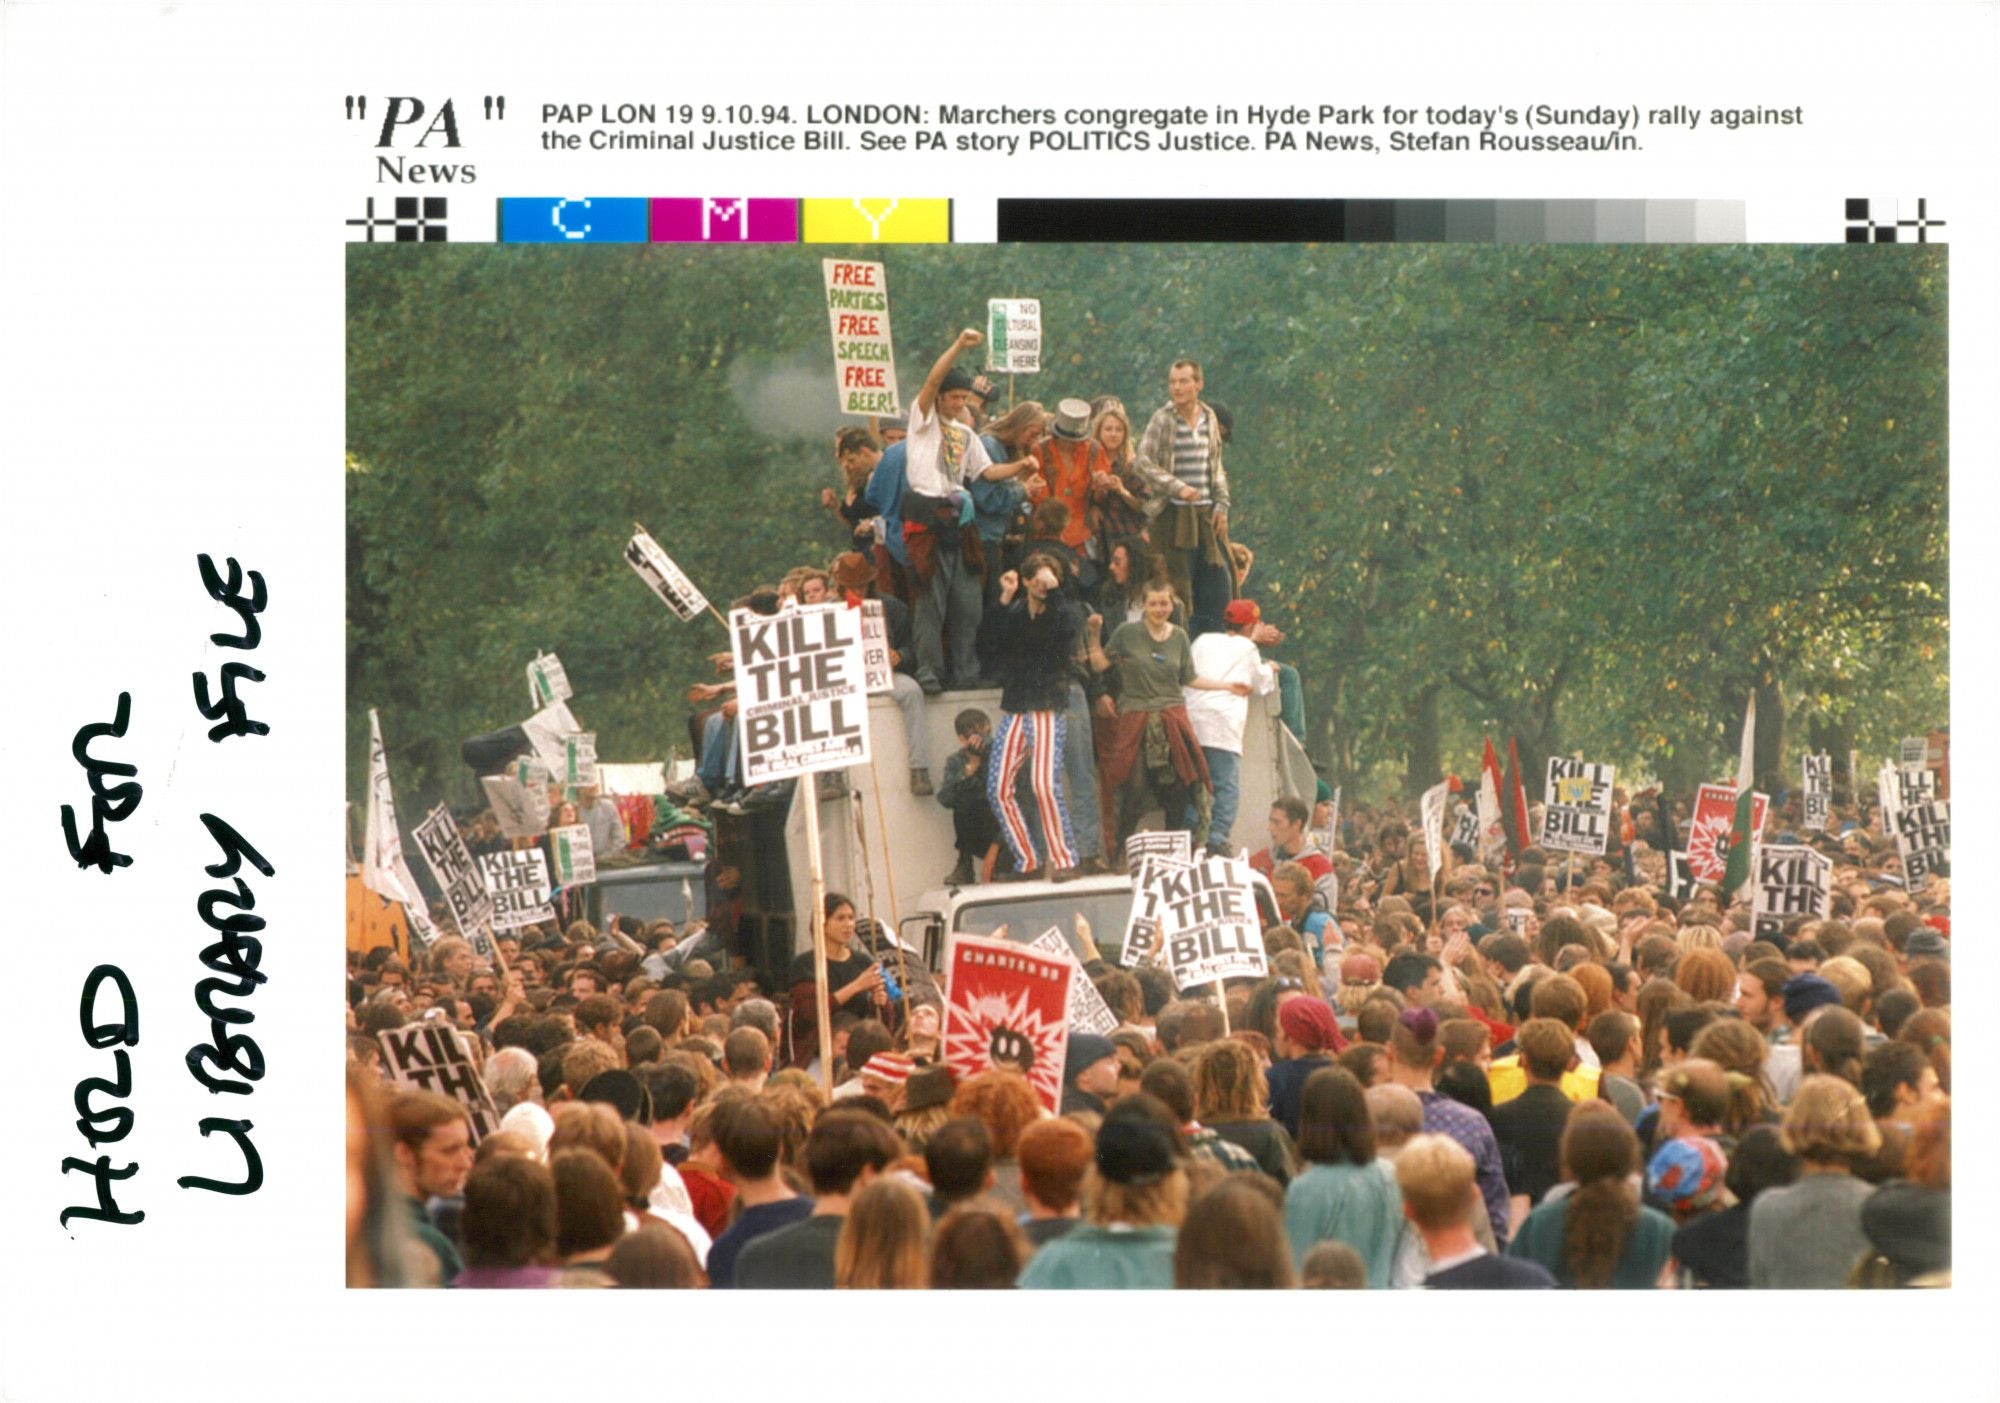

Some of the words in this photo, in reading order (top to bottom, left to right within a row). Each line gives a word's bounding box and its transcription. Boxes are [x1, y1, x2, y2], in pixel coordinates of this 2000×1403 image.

[833, 263, 876, 286] FREE
[1020, 304, 1037, 316] NO
[838, 314, 879, 336] FREE
[837, 341, 890, 363] SPEECH
[1012, 355, 1038, 368] HERE
[845, 366, 885, 388] FREE
[847, 391, 897, 415] BEER!
[737, 612, 854, 667] KILL
[747, 650, 848, 702] THE
[746, 695, 804, 718] CRIMINAL
[809, 684, 857, 703] JUSTICE
[746, 699, 861, 754] BILL
[1551, 782, 1604, 810] TE
[1546, 811, 1604, 839] BILL
[485, 850, 542, 872] KILL
[490, 866, 541, 890] THE
[1161, 861, 1247, 904] KILL
[492, 888, 549, 914] BILL
[1169, 890, 1245, 929] THE
[1763, 886, 1823, 917] THE
[1170, 926, 1259, 967] BILL
[387, 1027, 468, 1070] KIL
[407, 1063, 481, 1101] TH
